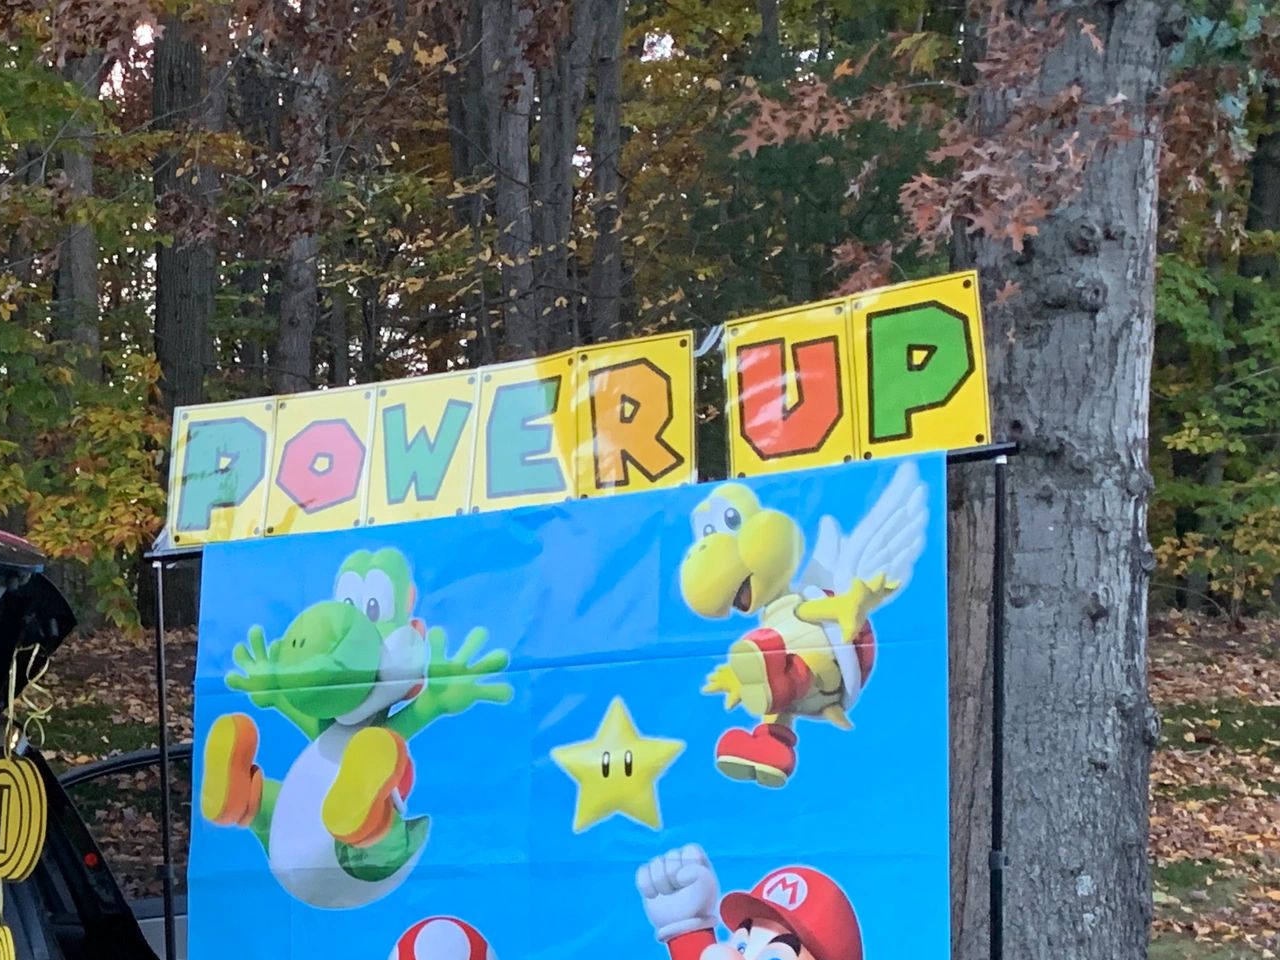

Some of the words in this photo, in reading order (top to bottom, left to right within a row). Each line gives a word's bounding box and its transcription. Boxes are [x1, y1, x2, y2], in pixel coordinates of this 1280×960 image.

[176, 358, 685, 531] POWER
[738, 299, 976, 461] UP
[766, 877, 799, 904] M
